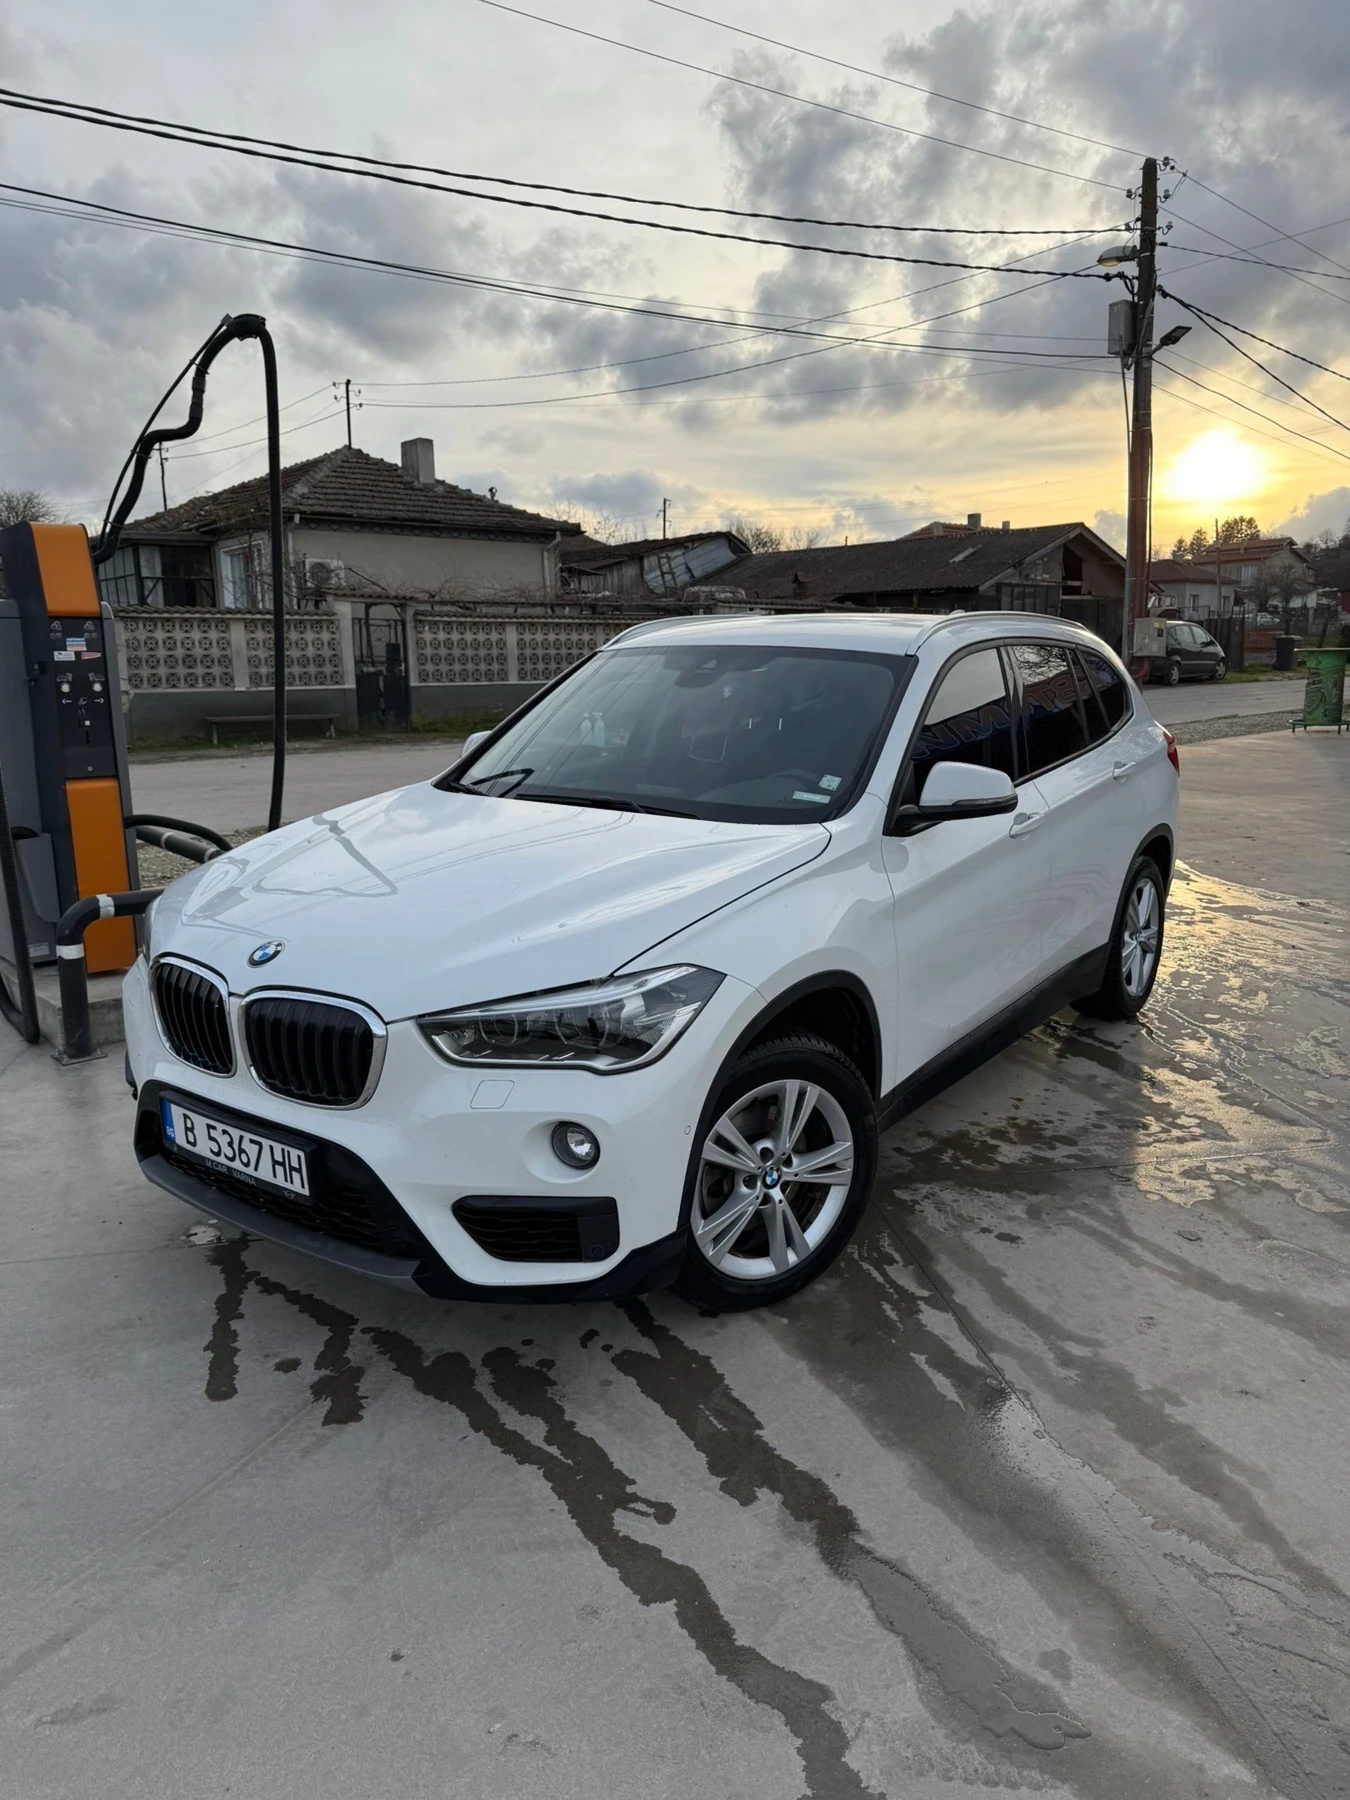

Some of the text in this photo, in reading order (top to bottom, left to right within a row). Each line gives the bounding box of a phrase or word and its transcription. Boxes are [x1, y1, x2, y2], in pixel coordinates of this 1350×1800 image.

[166, 1125, 175, 1138] BG
[183, 1112, 305, 1190] B 5367 HH
[231, 1169, 257, 1186] VARNA
